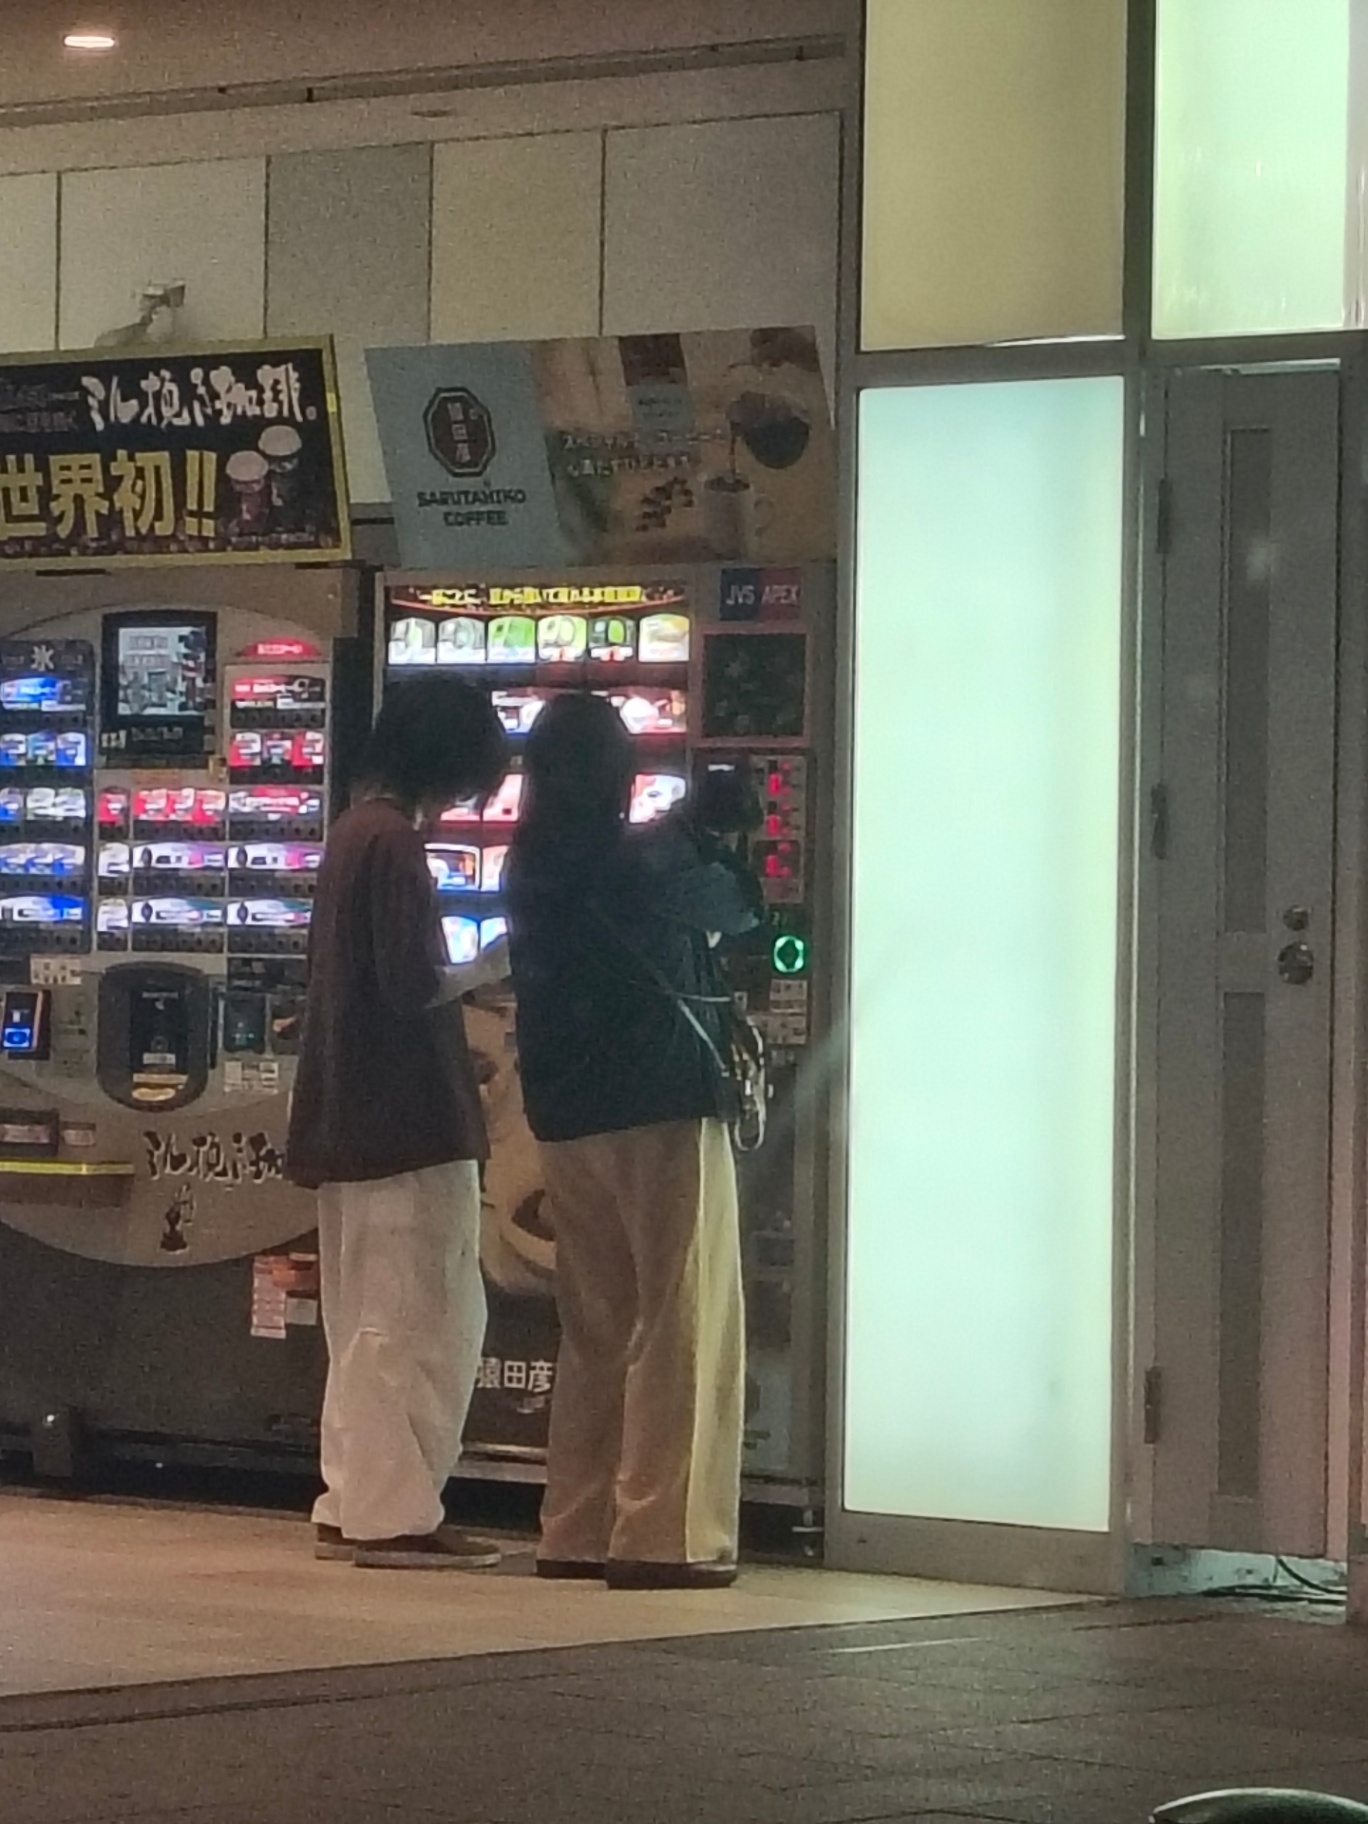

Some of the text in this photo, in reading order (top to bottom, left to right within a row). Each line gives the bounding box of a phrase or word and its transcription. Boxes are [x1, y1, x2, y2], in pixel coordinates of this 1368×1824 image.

[417, 489, 526, 507] SARUTAHIKO
[443, 510, 508, 527] COFFEE
[726, 584, 755, 605] JVS
